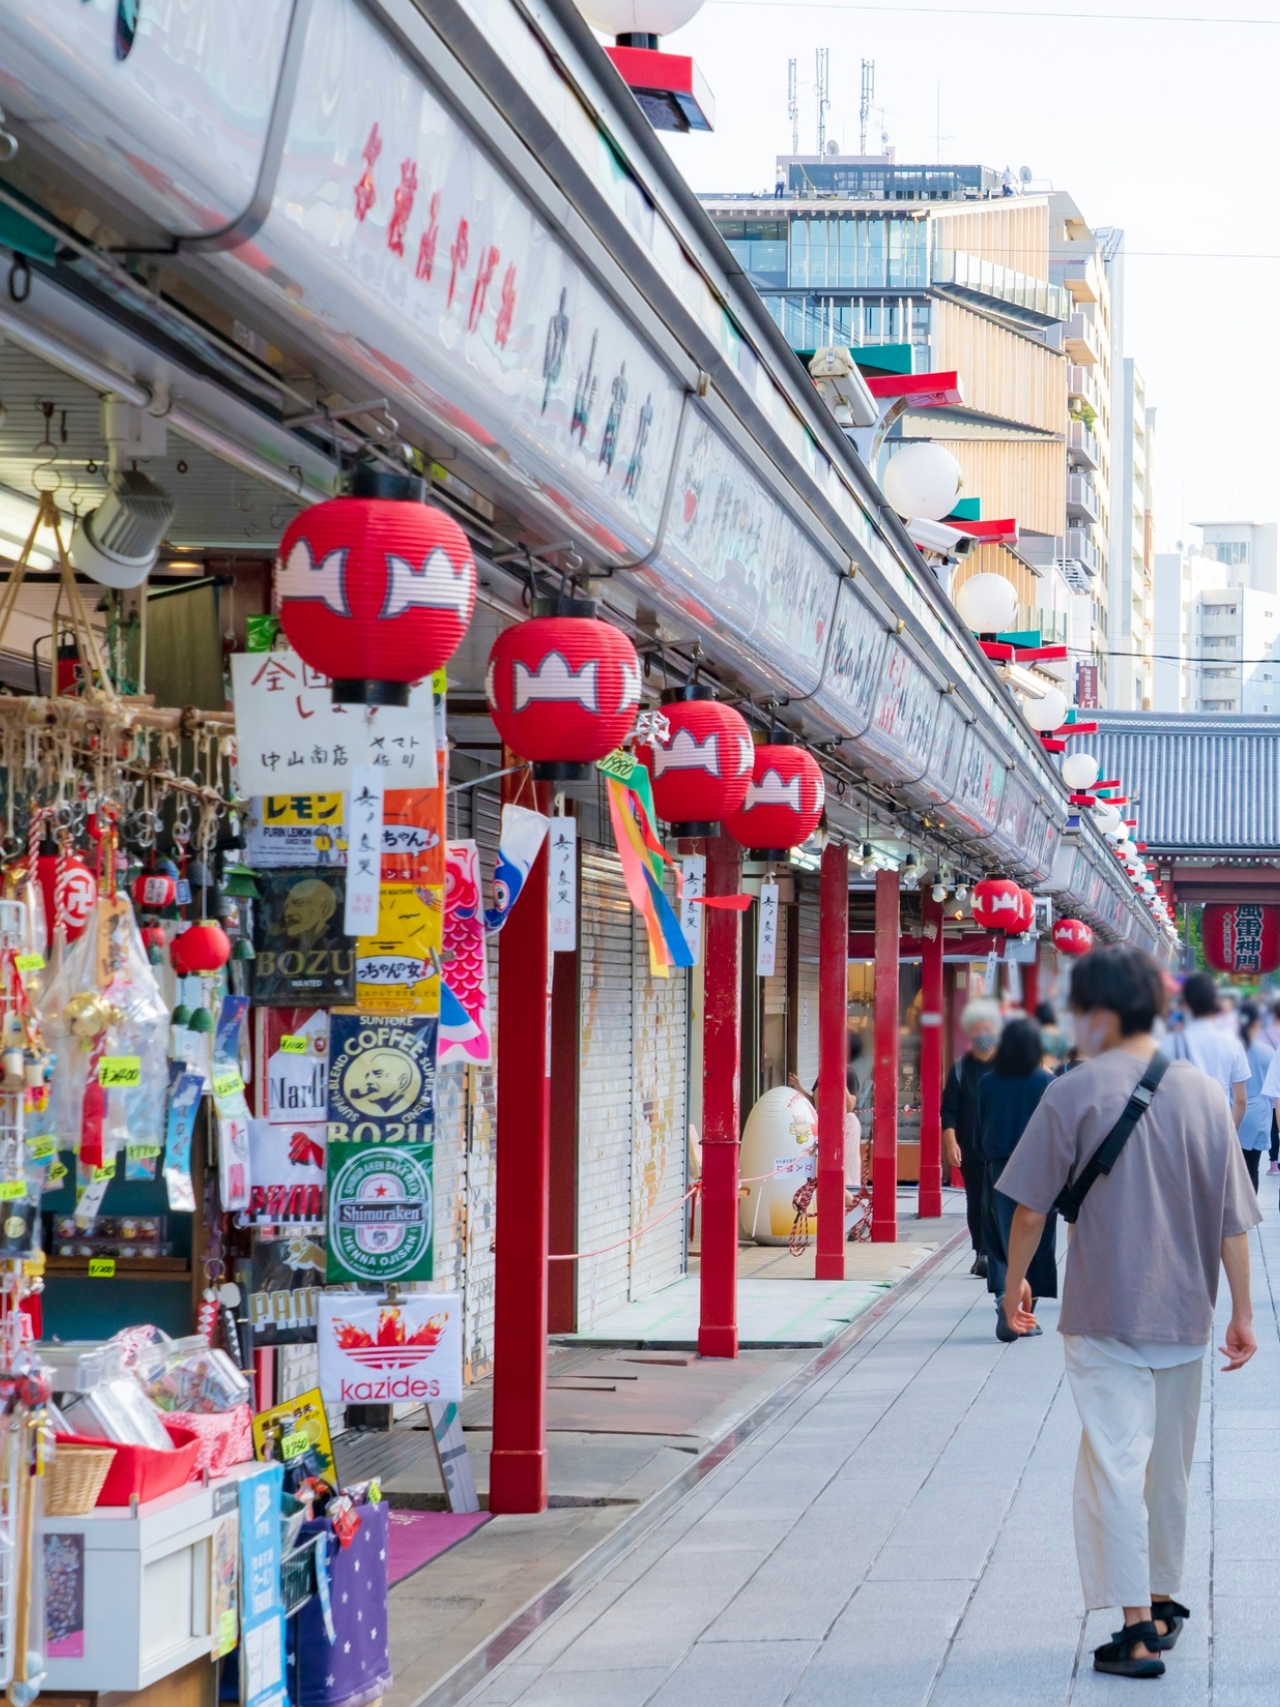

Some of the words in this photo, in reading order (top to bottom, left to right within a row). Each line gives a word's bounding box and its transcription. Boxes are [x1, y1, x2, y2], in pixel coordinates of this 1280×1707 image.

[369, 735, 420, 750] ヤマト
[260, 744, 349, 772] 中山商店
[267, 795, 338, 820] レモン
[256, 950, 355, 977] BOZU
[343, 1027, 428, 1061] COFFEE
[328, 1053, 349, 1090] BLEND
[342, 1205, 420, 1222] Shimuraken
[343, 1234, 376, 1266] HENNA
[379, 1235, 417, 1267] OJISAN
[341, 1375, 441, 1402] kazides
